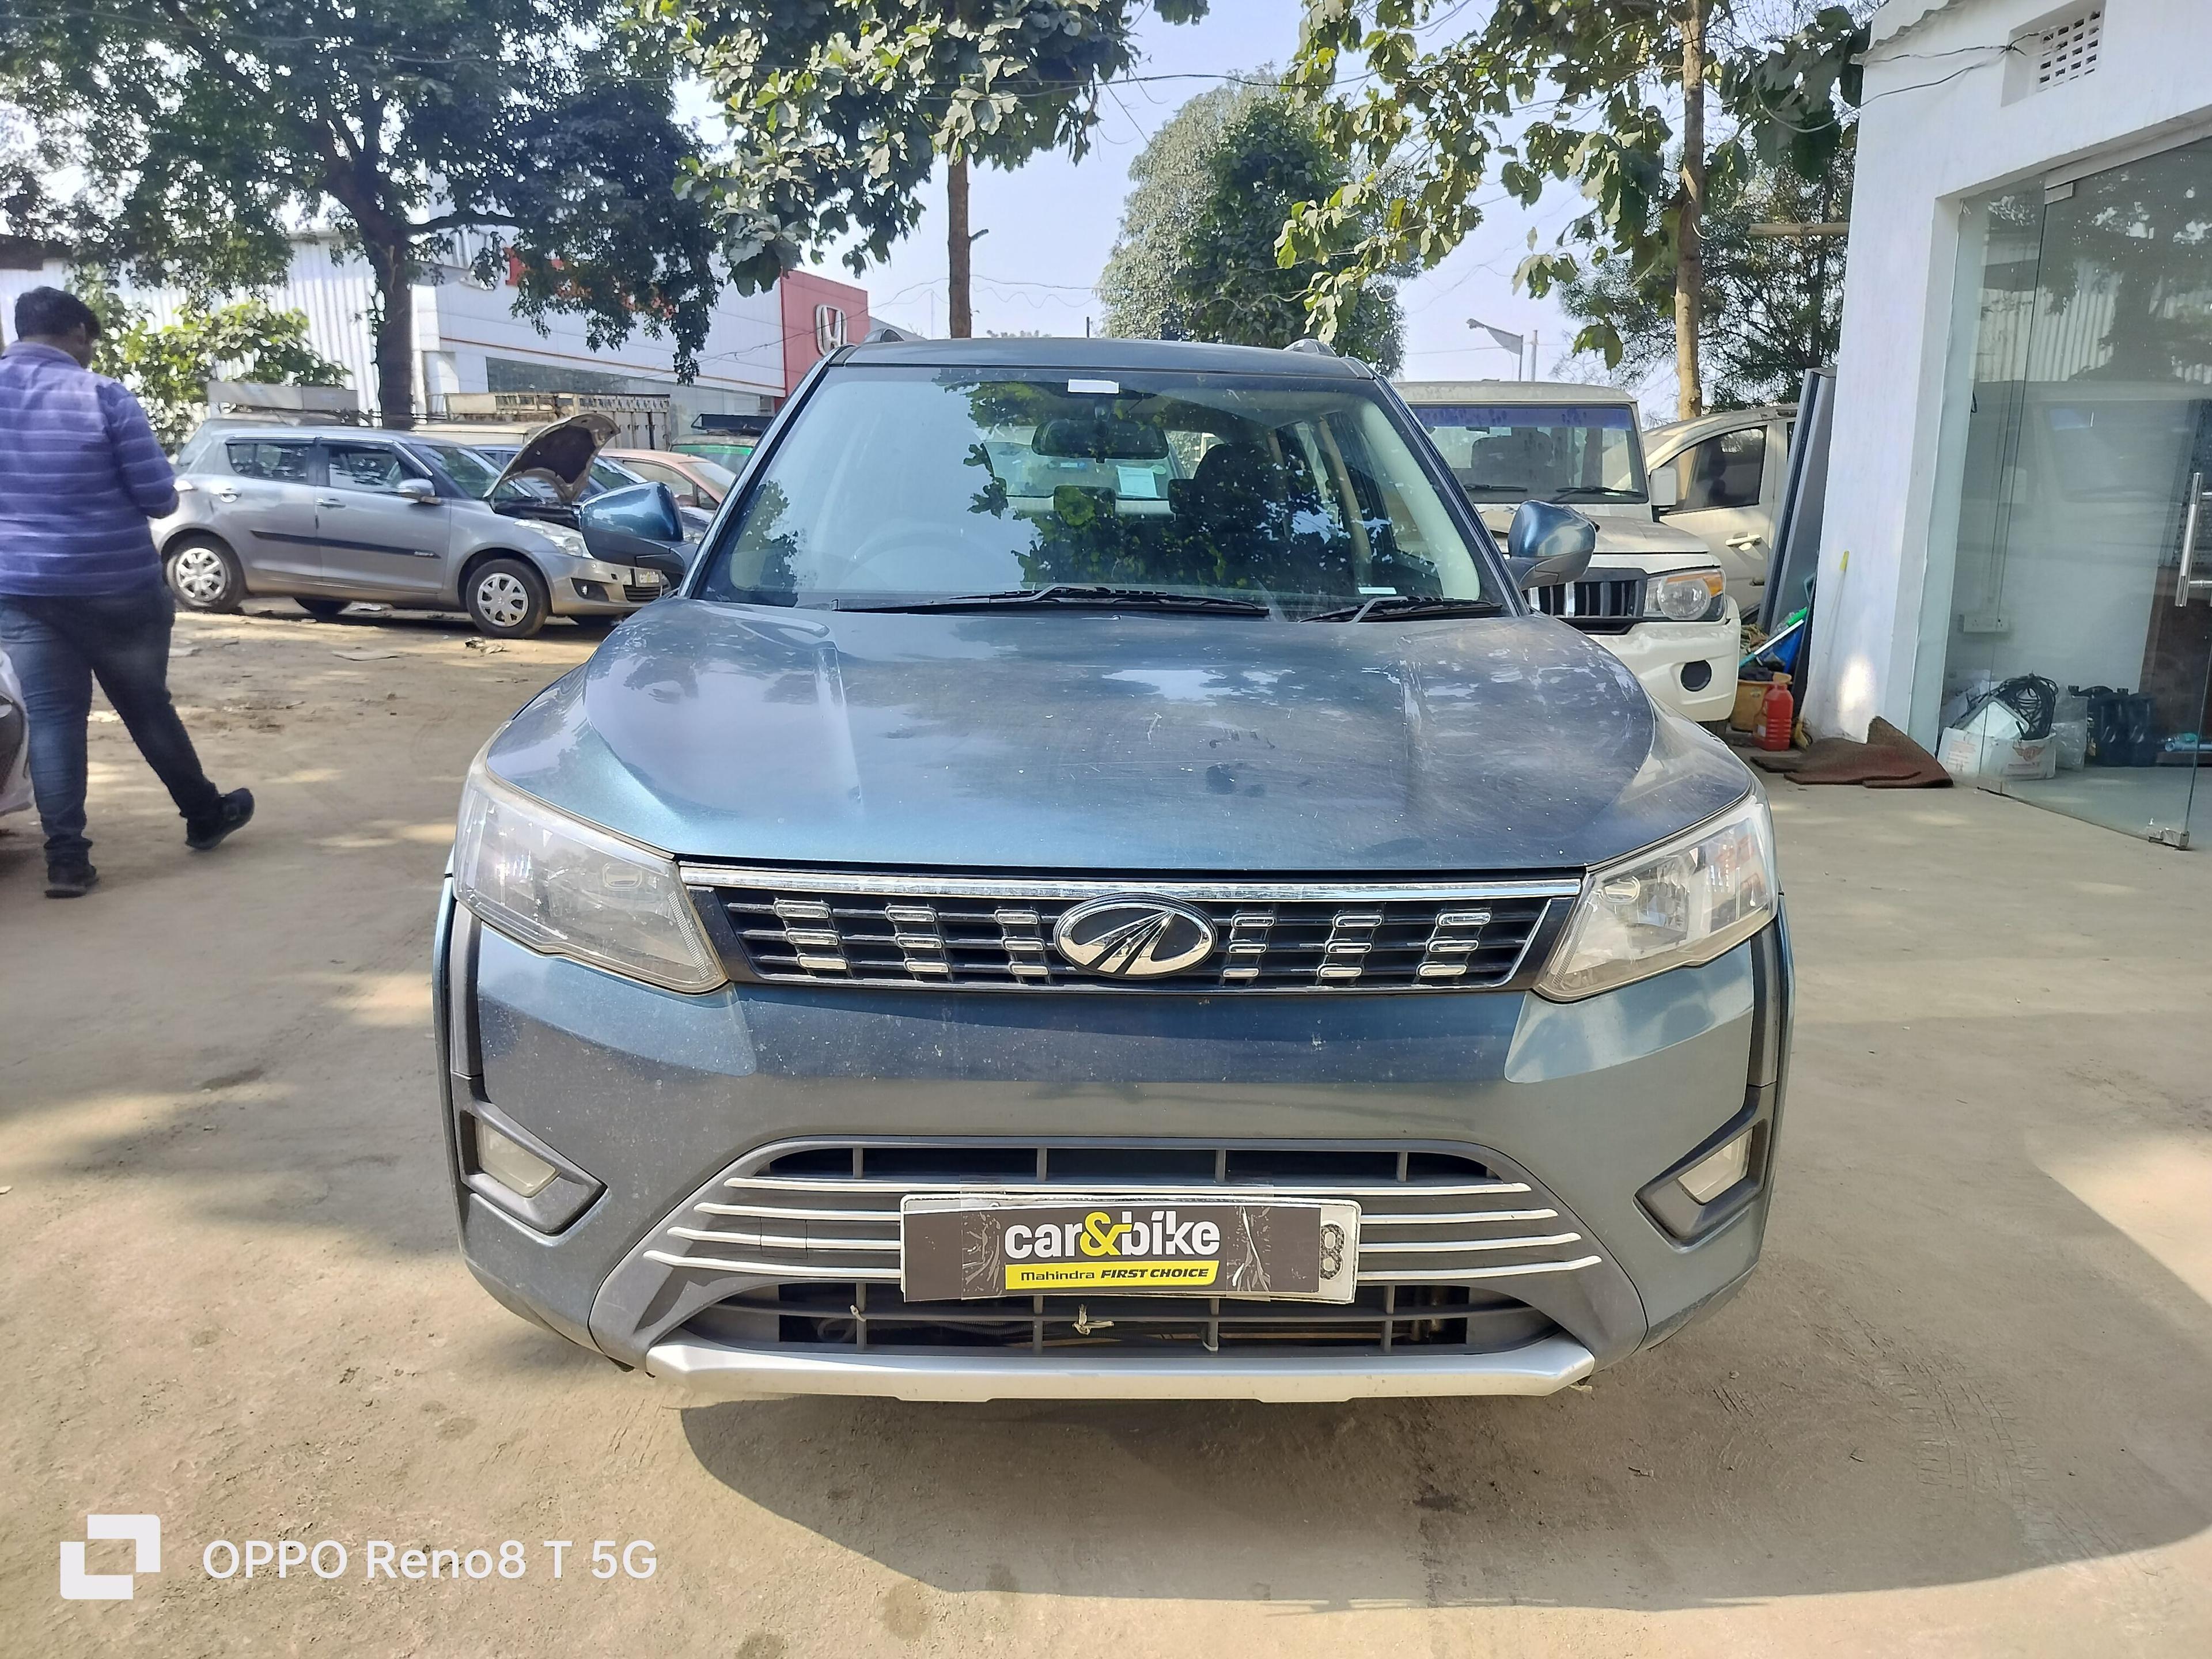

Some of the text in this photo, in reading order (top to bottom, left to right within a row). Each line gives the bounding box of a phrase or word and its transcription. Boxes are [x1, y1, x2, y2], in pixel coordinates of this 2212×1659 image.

[1005, 1210, 1221, 1259] car&bike
[1021, 1268, 1209, 1281] Mahindra FIRST CHOICE
